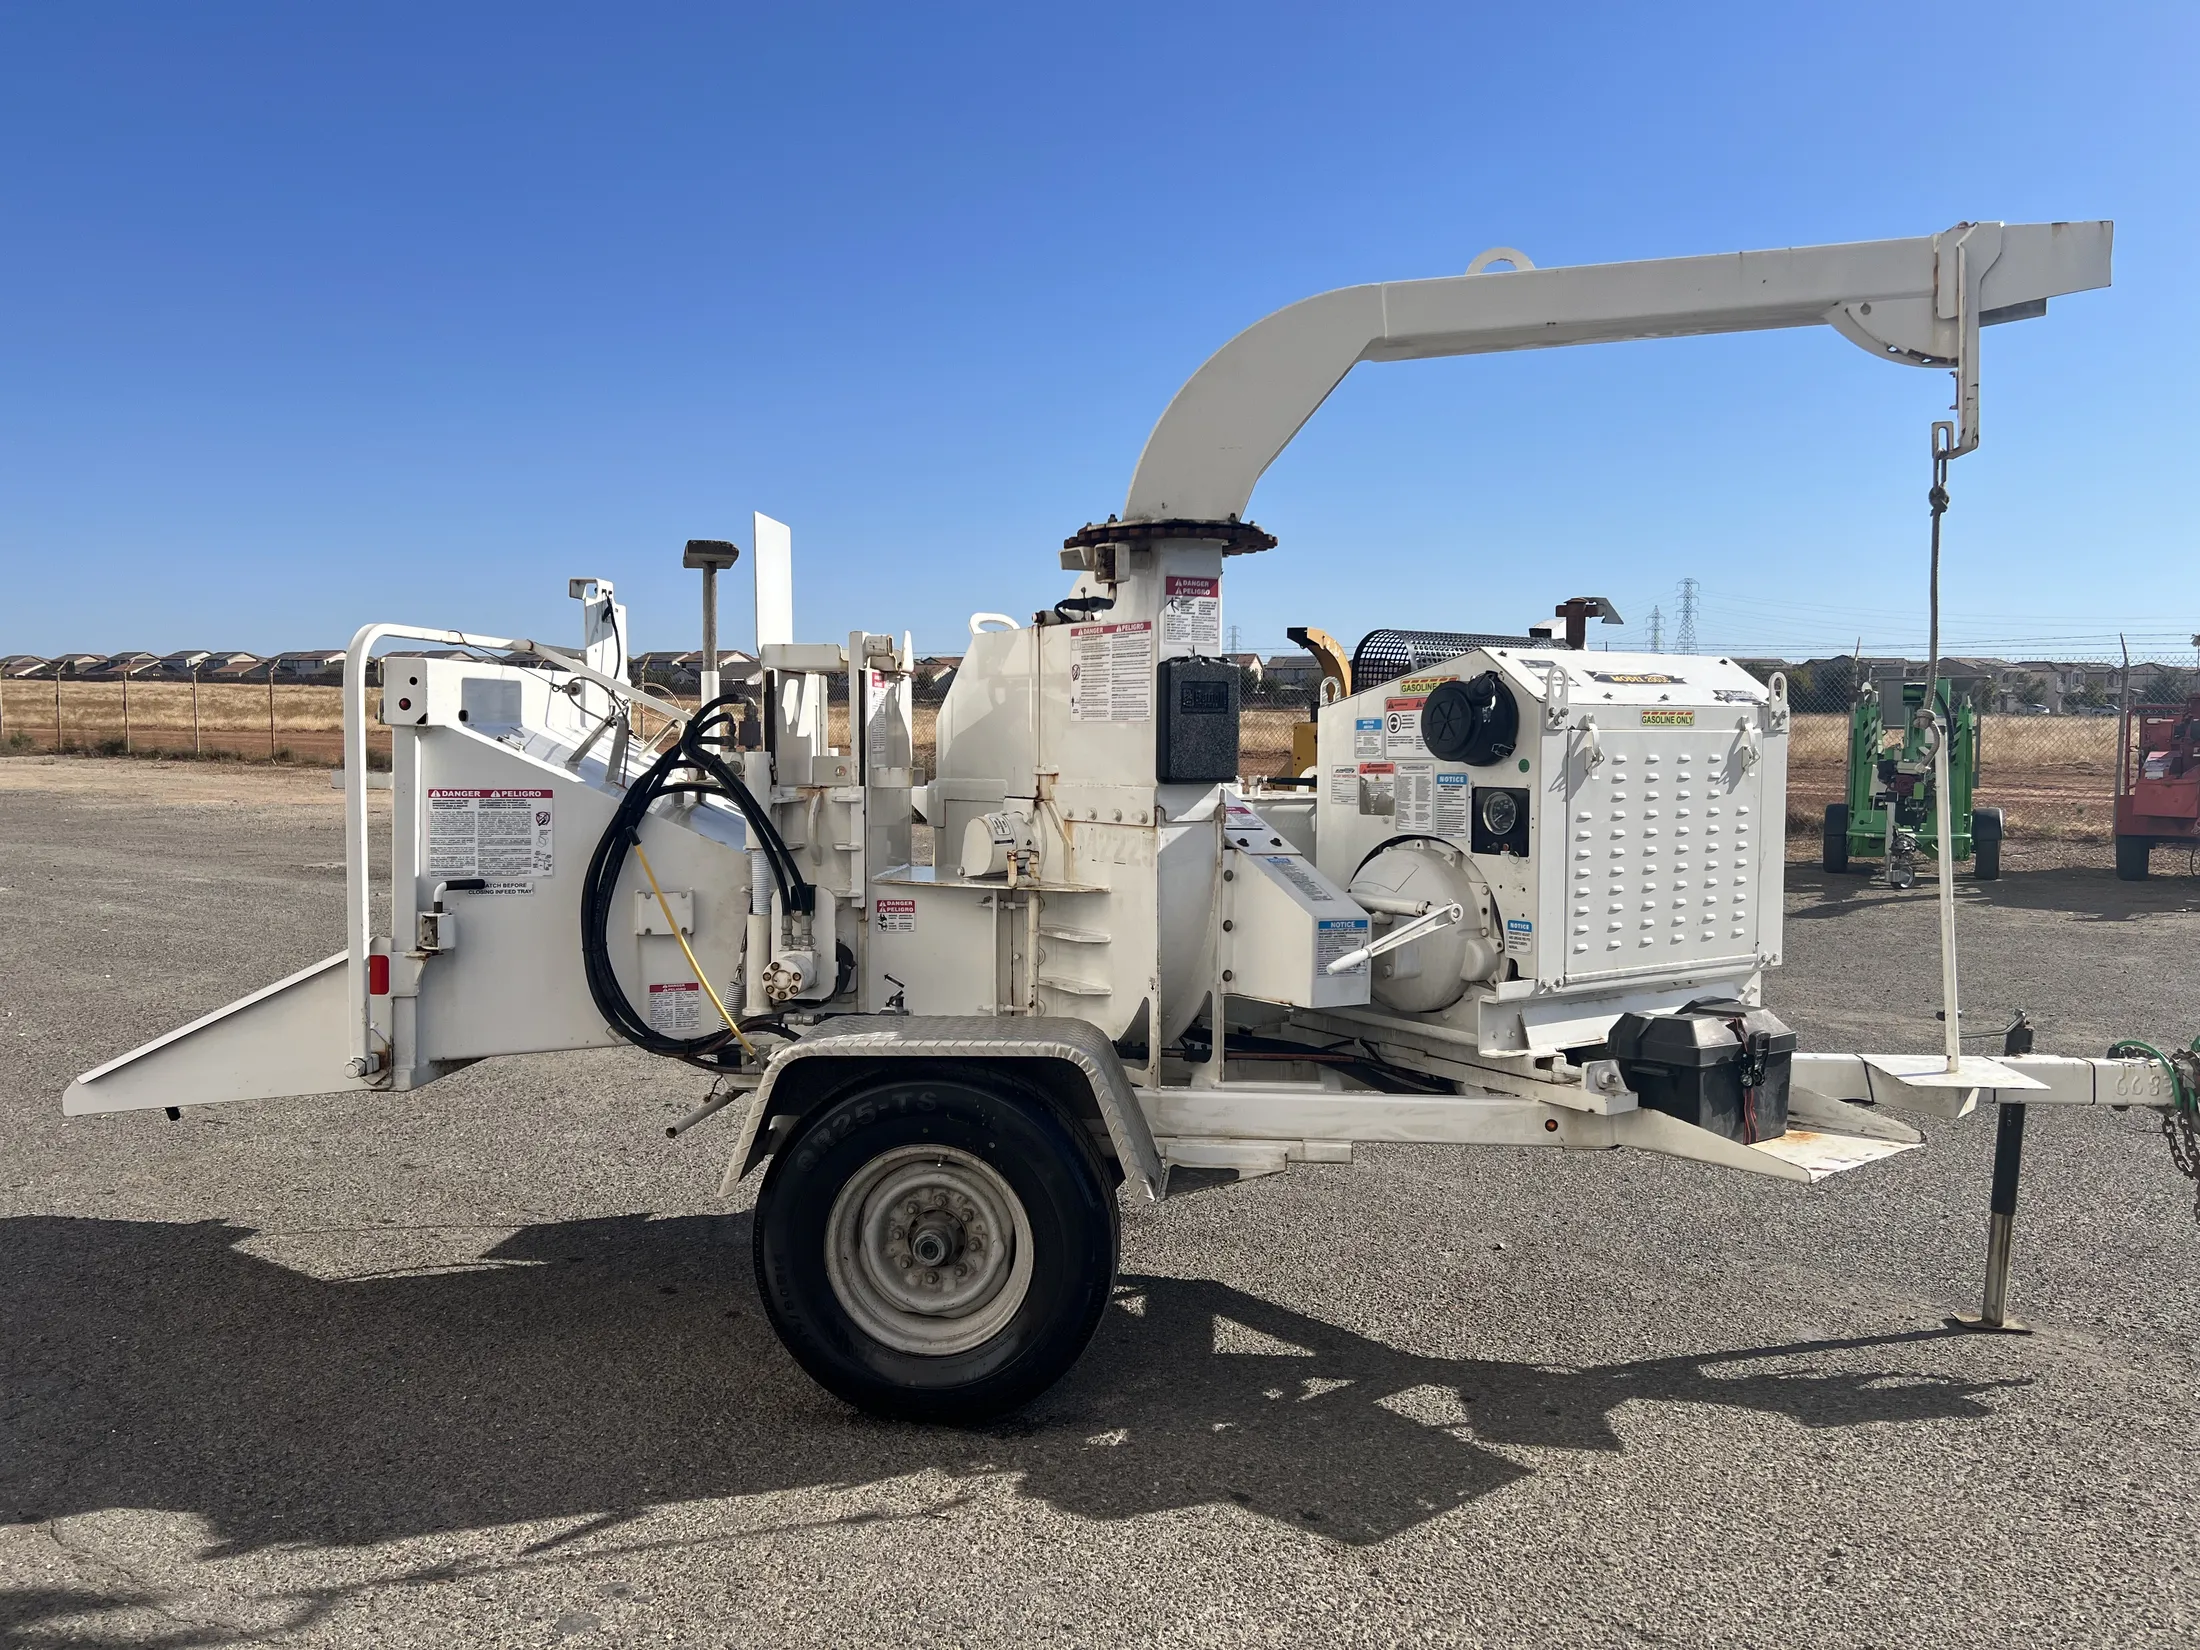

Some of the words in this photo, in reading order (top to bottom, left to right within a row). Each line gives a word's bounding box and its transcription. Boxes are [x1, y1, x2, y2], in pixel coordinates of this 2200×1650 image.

[1183, 587, 1210, 595] PELIGRO
[1083, 627, 1104, 635] DANGER
[1121, 623, 1145, 632] PELIGRO
[1401, 683, 1436, 692] GASOLINE
[1642, 716, 1675, 724] GASOLINE
[1676, 716, 1693, 724] ONLY
[1510, 922, 1529, 930] NOTICE
